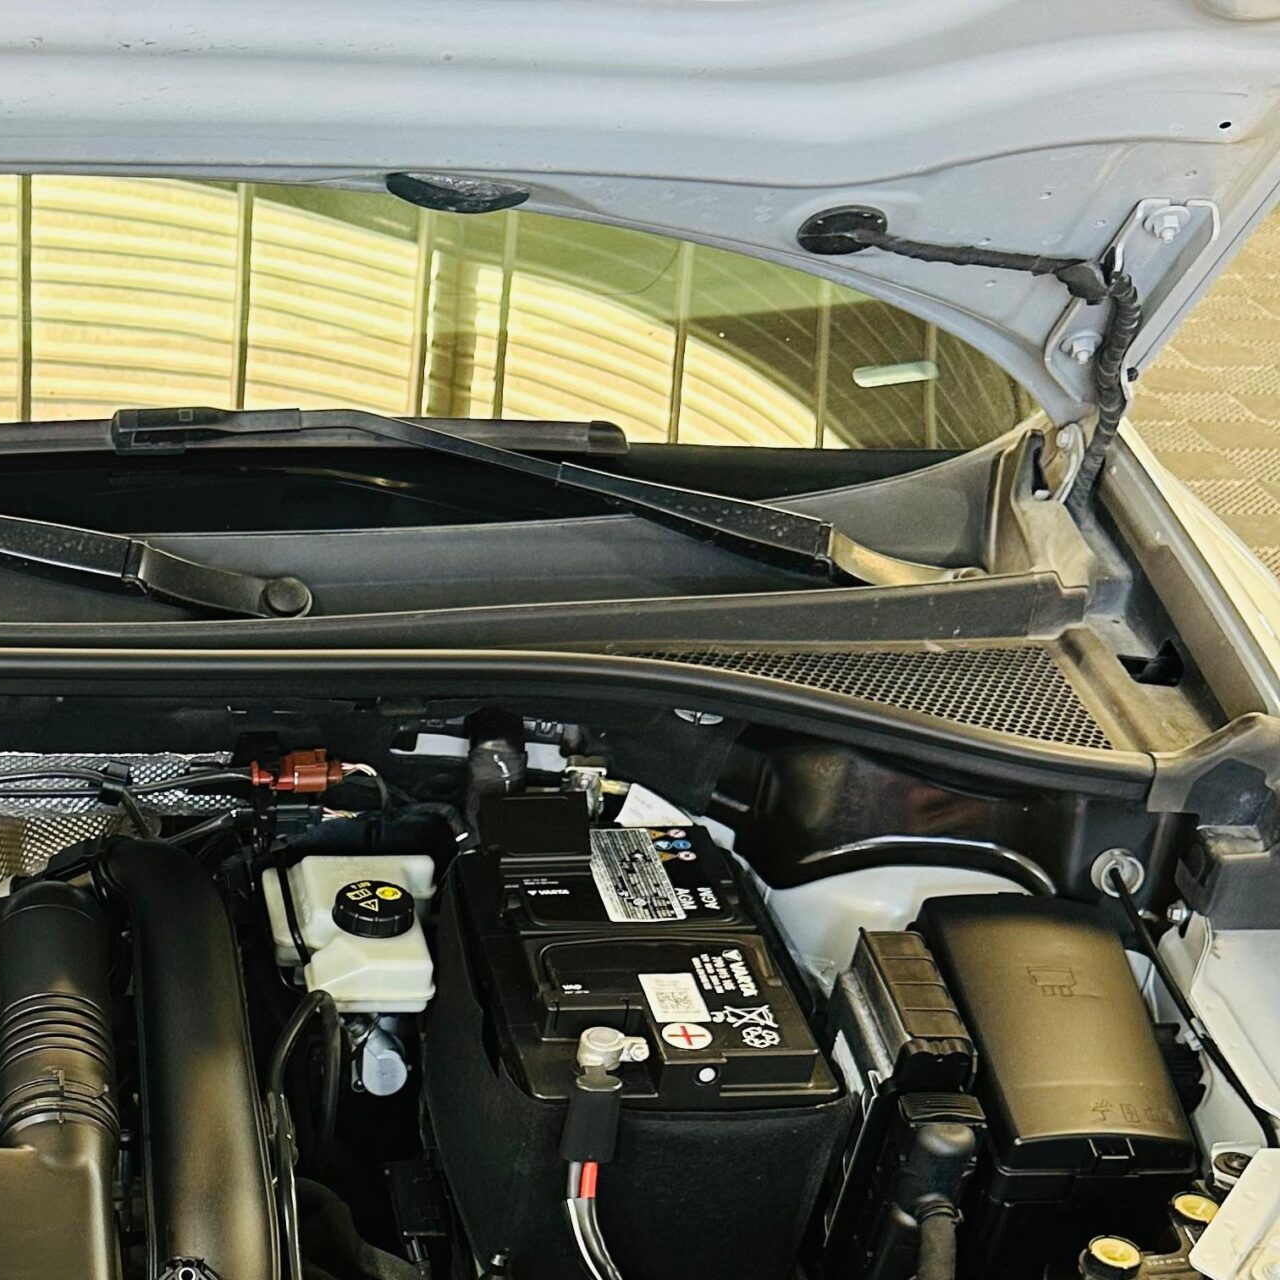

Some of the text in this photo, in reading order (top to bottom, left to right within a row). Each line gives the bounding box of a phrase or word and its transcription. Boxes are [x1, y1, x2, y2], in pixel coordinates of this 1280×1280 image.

[674, 887, 698, 910] AGM
[697, 887, 720, 910] AGM
[729, 961, 758, 997] VARTA
